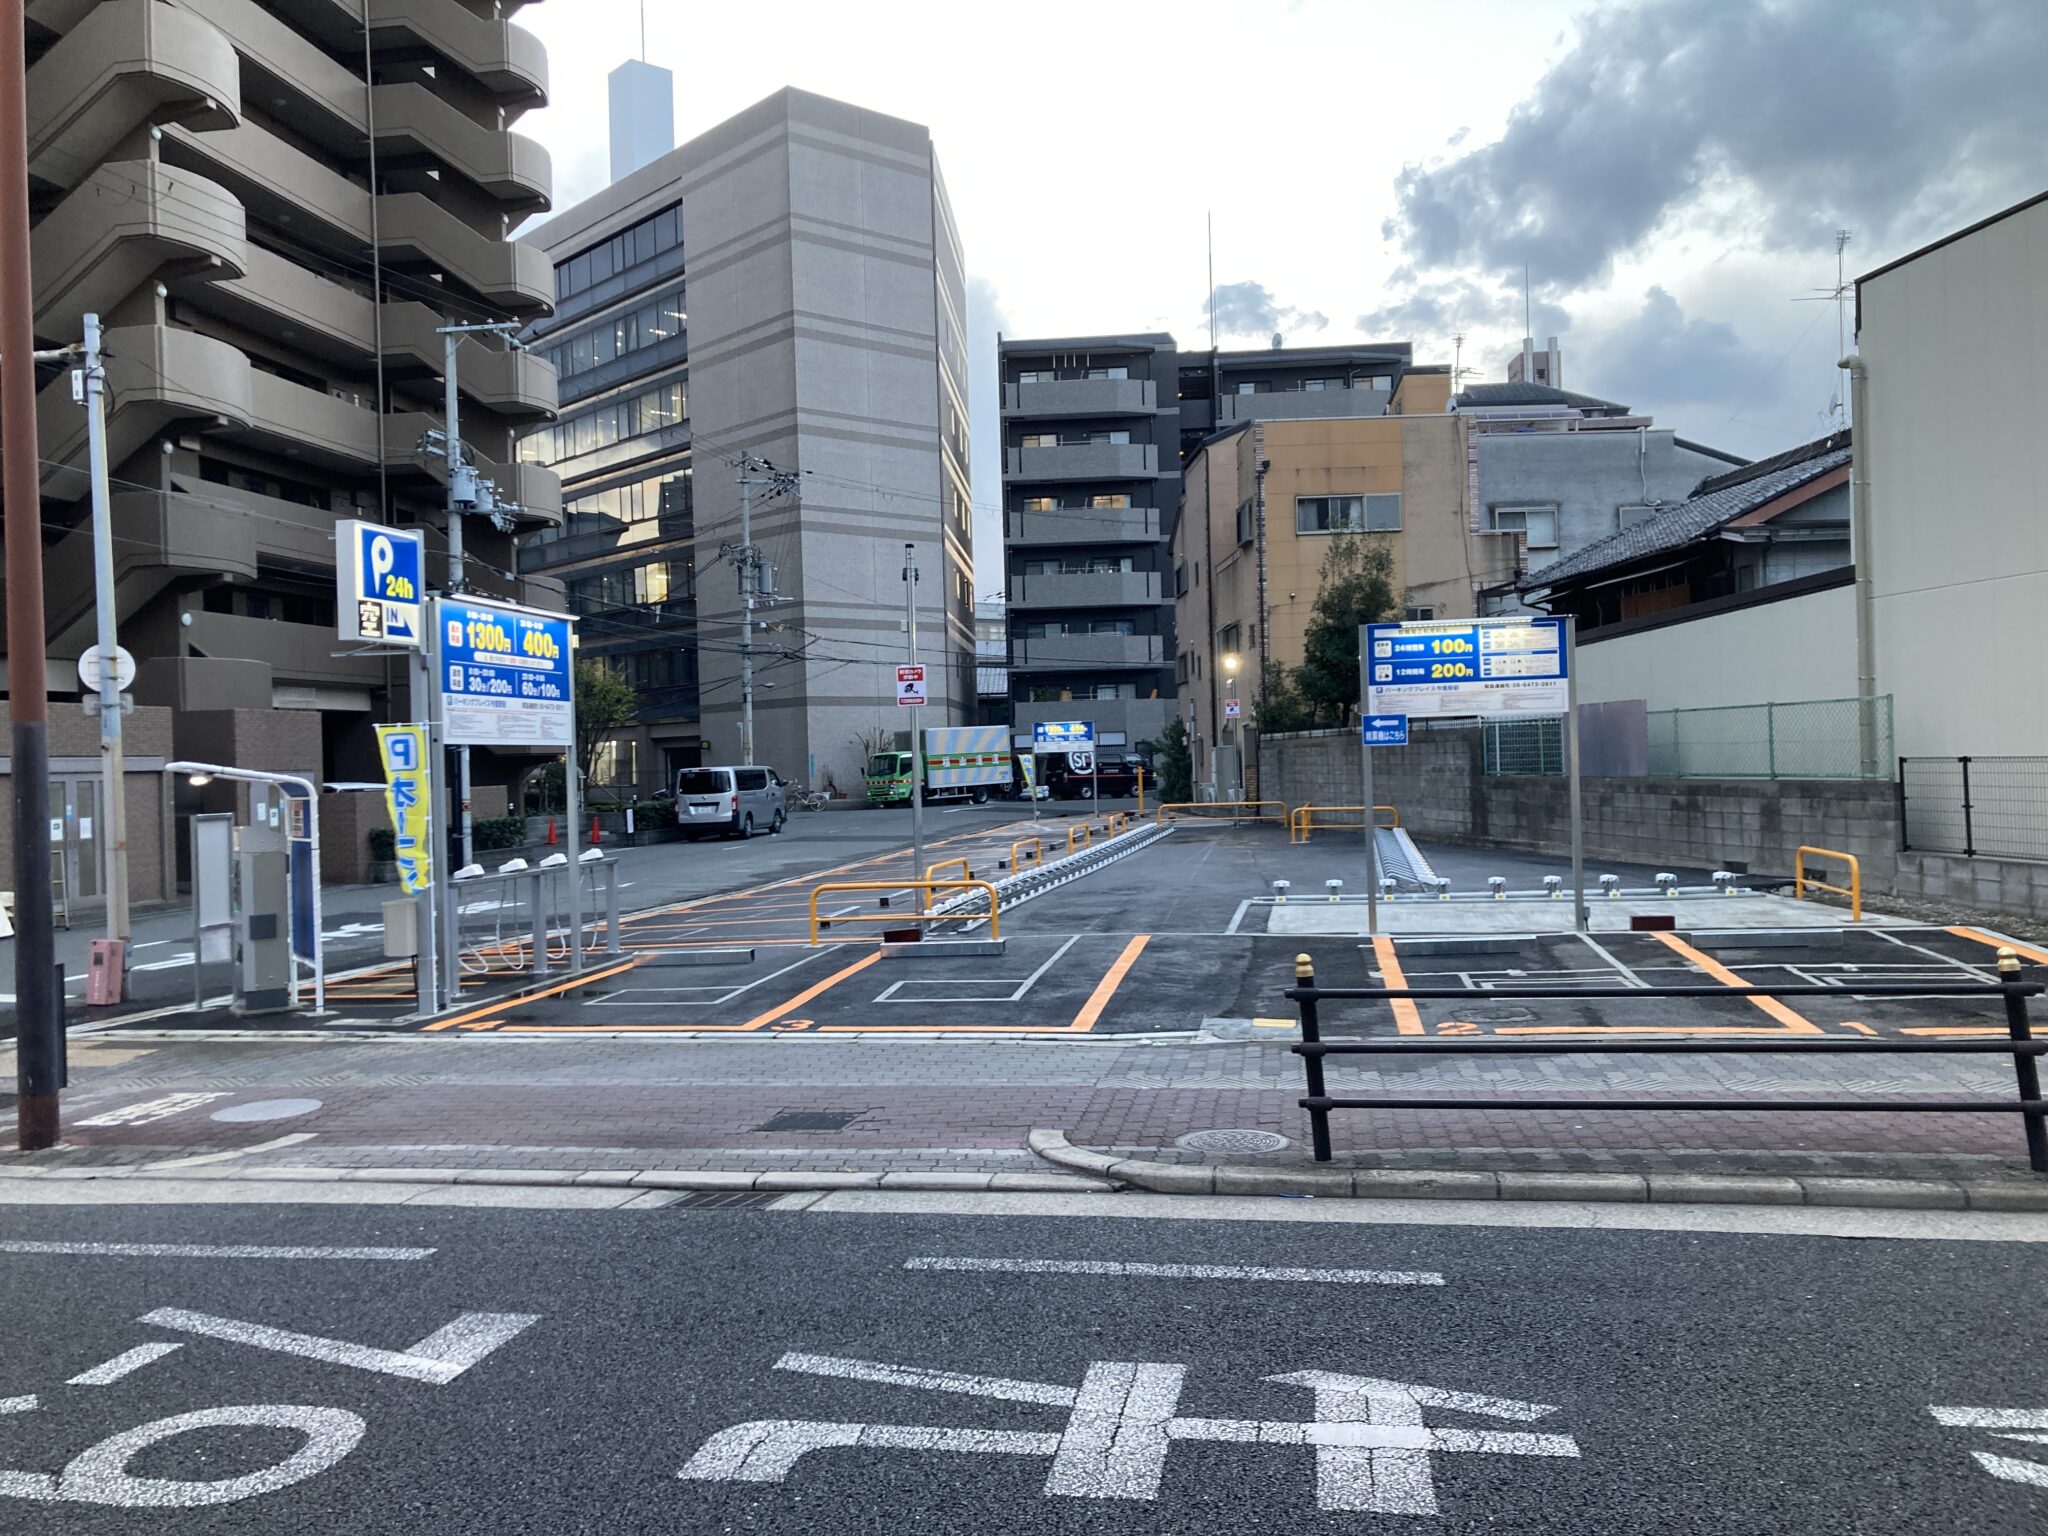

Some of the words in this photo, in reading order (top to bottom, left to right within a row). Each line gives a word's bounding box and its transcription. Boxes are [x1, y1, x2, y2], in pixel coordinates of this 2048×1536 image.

[371, 535, 394, 595] P
[385, 574, 414, 599] 24h
[360, 602, 381, 637] 空
[386, 607, 398, 623] IN
[467, 621, 511, 653] 1300円
[523, 630, 560, 659] 400円
[1431, 638, 1473, 654] 100円
[1431, 663, 1474, 678] 200円
[770, 1018, 815, 1031] 3
[1436, 1021, 1484, 1036] 2
